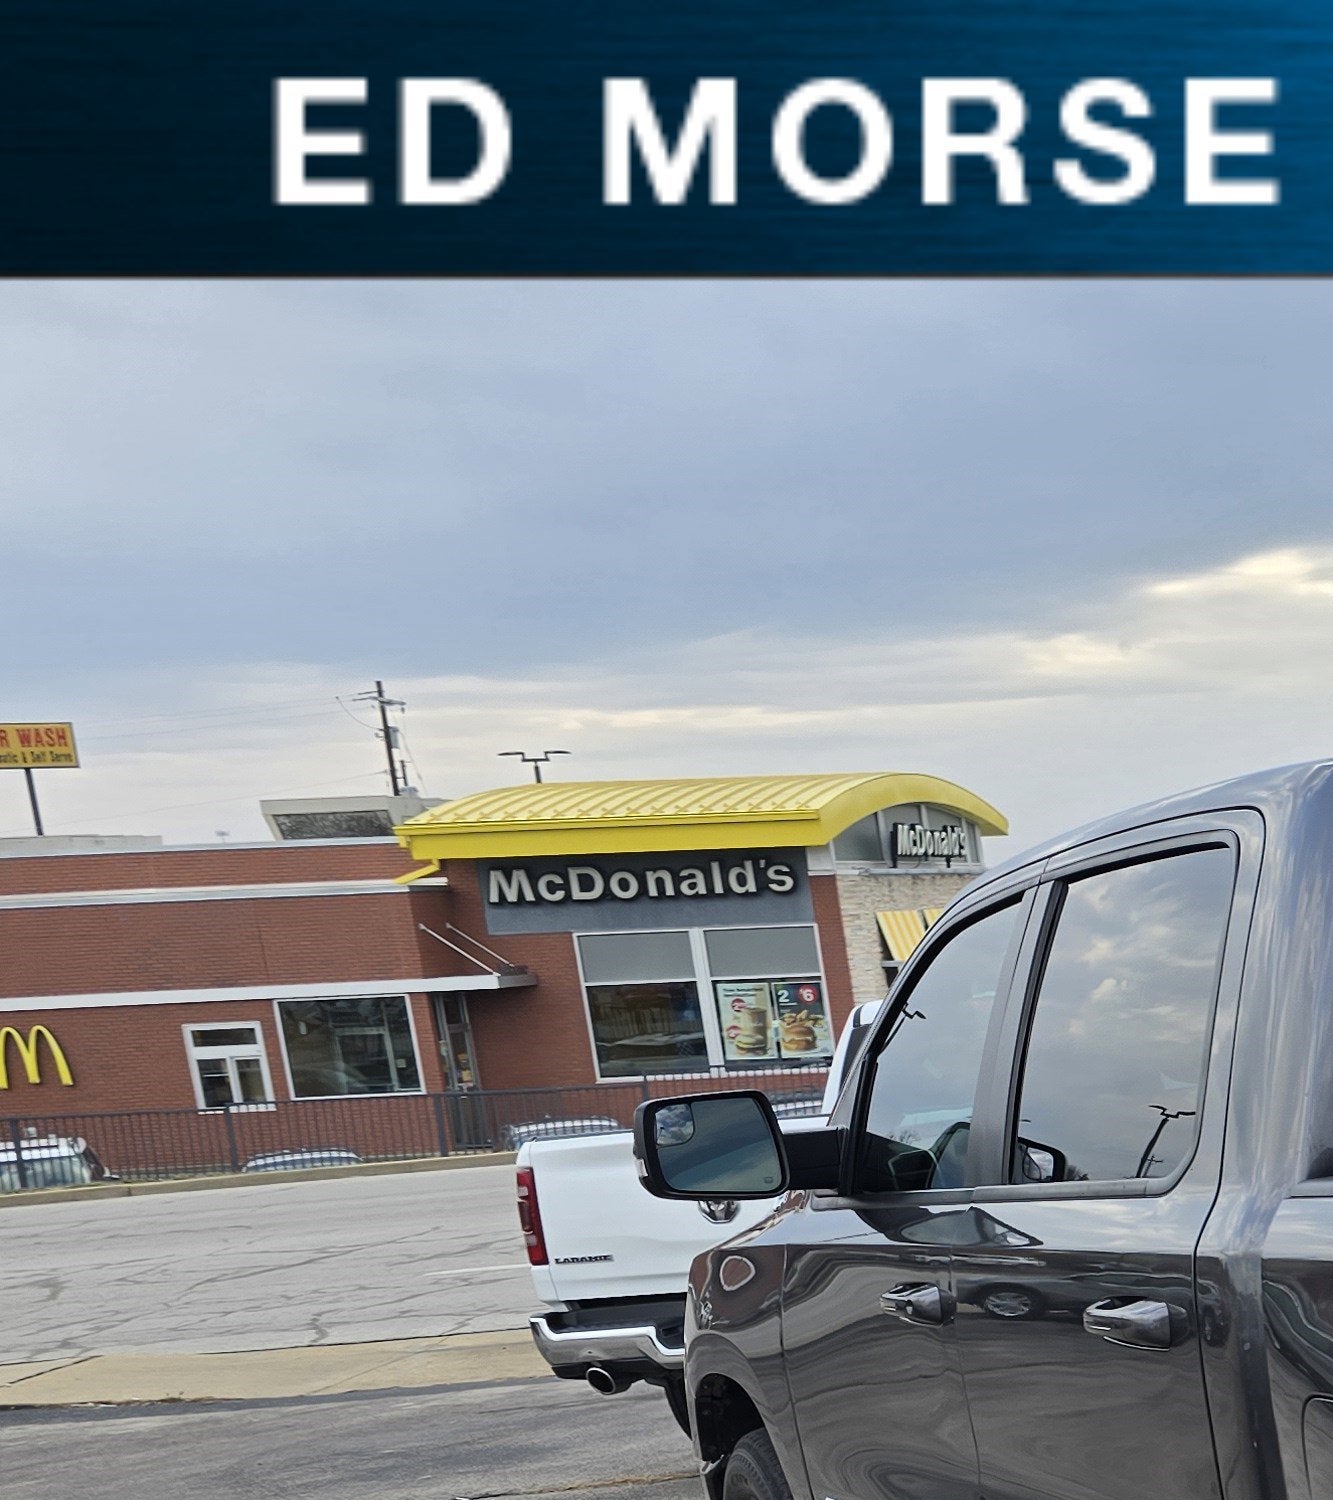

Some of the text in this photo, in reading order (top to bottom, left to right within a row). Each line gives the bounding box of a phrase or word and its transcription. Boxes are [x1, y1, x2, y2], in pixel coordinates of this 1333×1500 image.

[16, 727, 68, 748] WASH
[896, 823, 967, 857] McDonald's
[487, 858, 796, 905] McDonald's
[554, 1254, 615, 1265] LARAMIE
